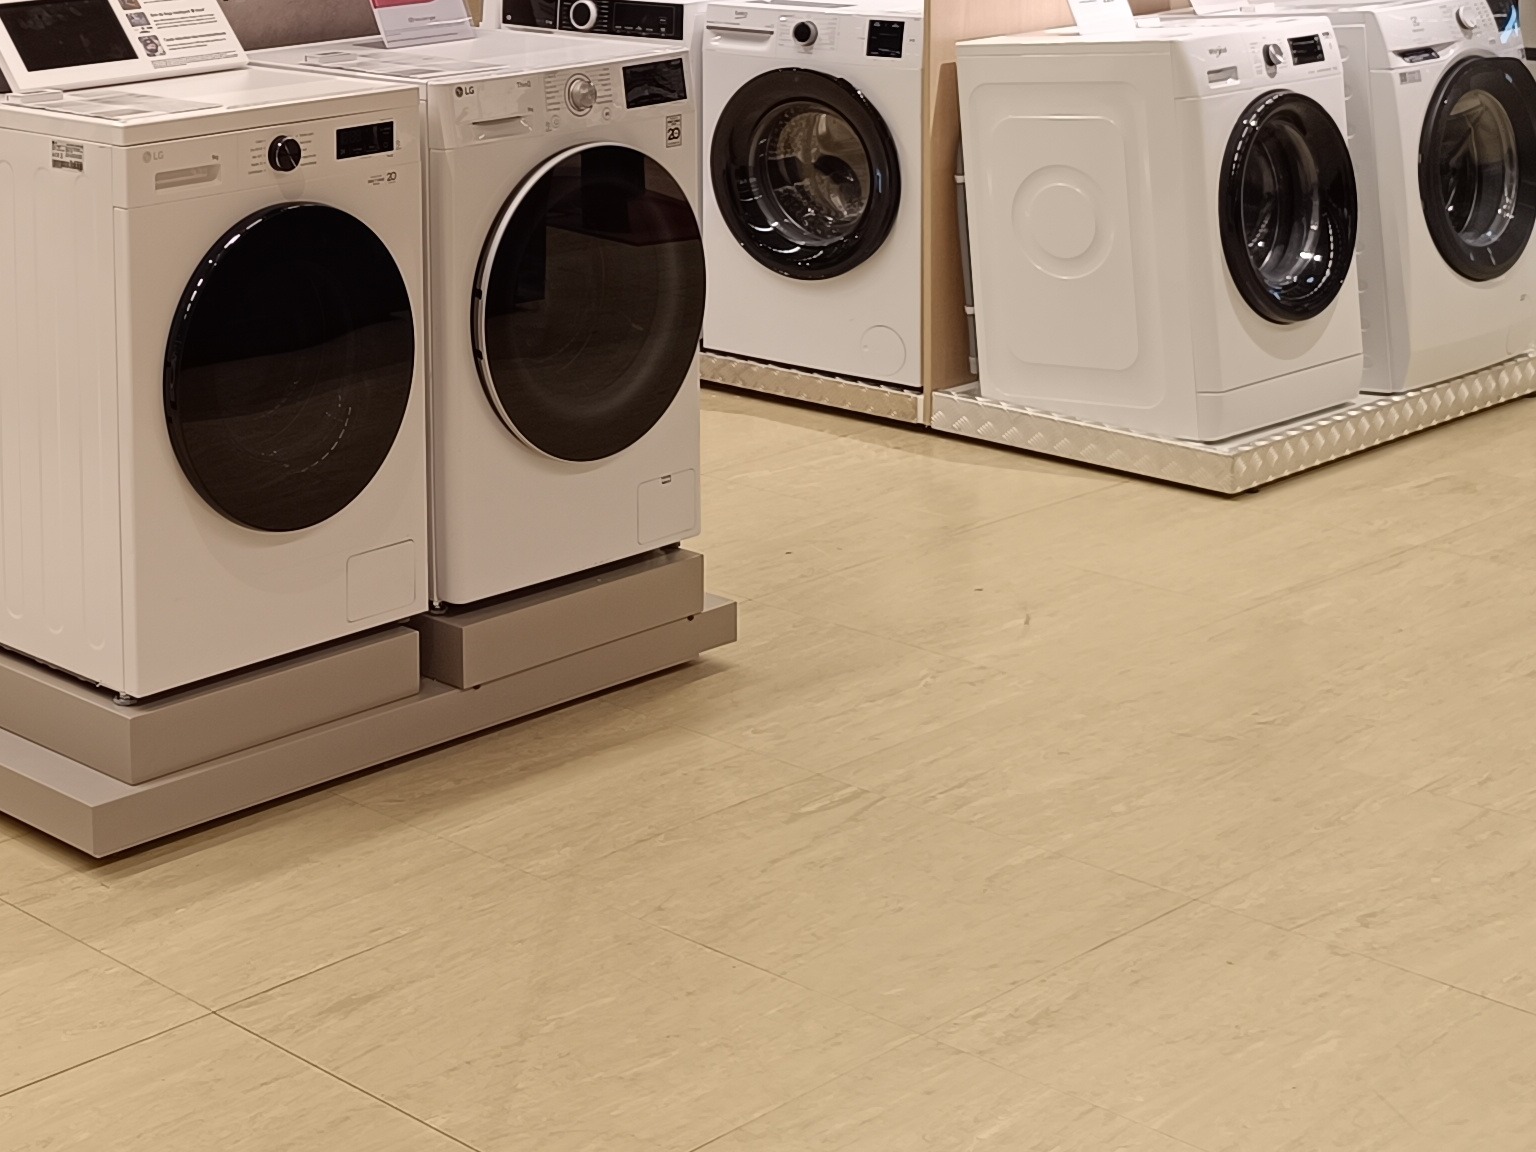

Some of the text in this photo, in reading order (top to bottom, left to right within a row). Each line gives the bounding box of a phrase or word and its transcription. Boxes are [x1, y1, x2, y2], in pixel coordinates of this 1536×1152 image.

[464, 86, 474, 95] LG
[667, 126, 681, 141] 20
[153, 151, 164, 160] LG
[386, 171, 397, 181] 20
